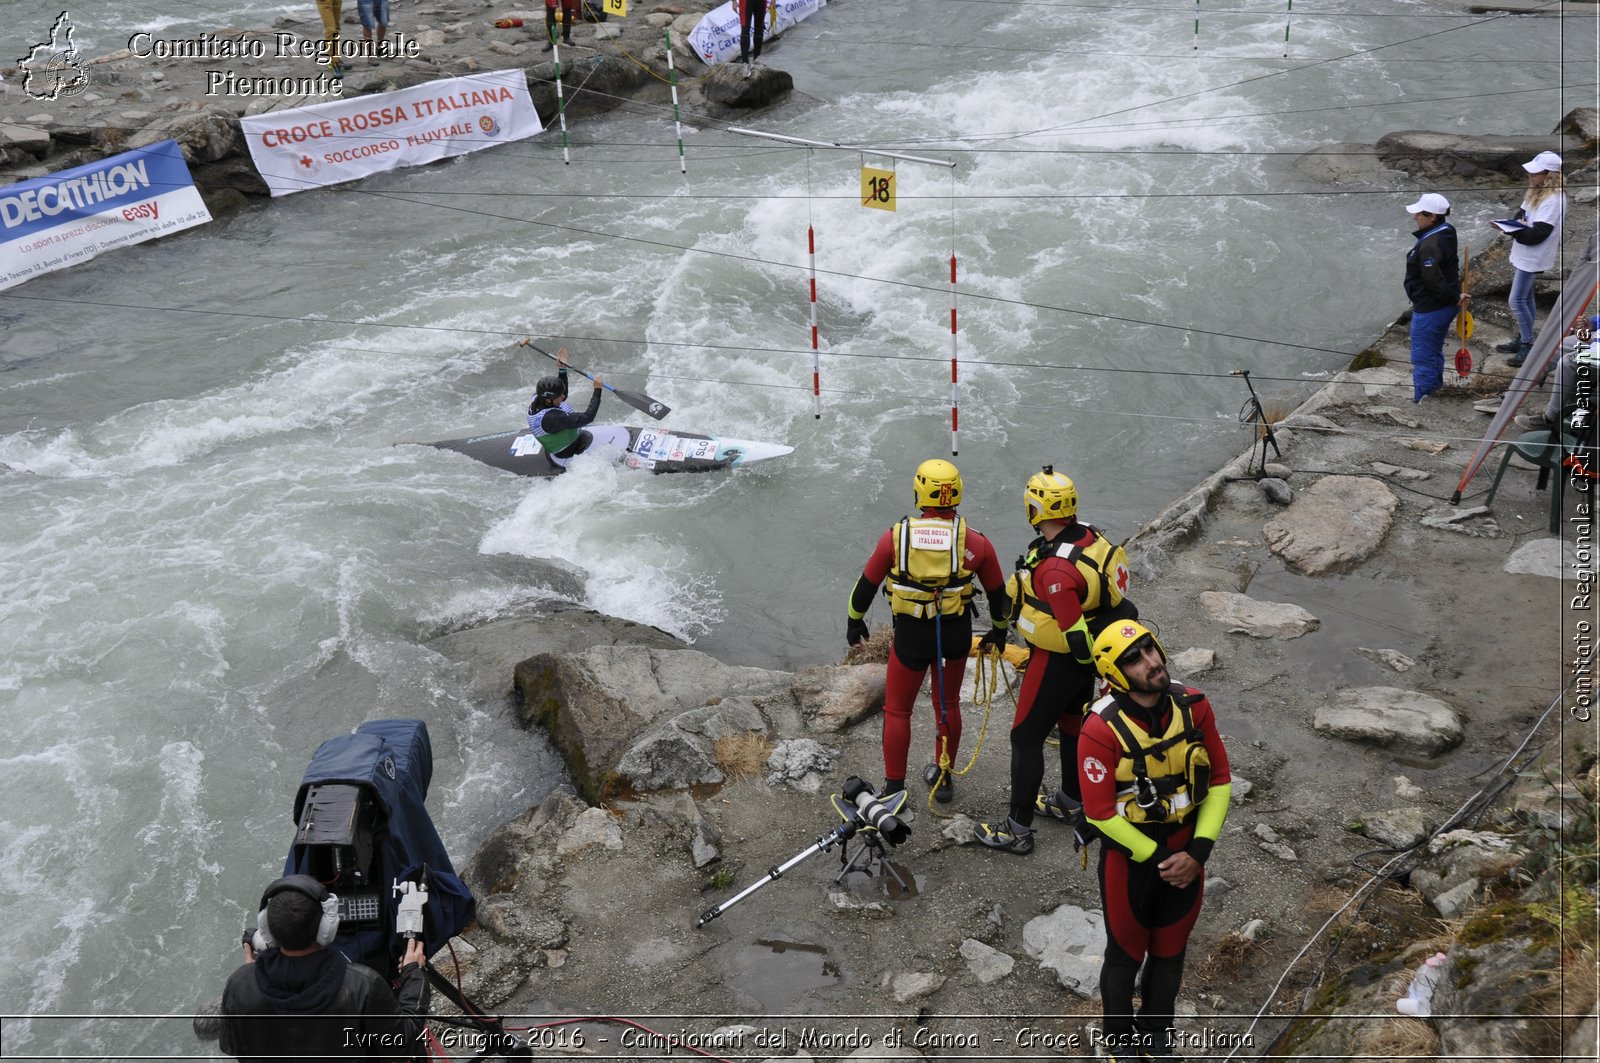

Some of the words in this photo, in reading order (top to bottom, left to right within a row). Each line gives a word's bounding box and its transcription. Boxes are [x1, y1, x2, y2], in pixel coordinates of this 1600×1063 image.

[261, 120, 333, 148] CROCE
[338, 107, 409, 134] ROSSA
[412, 87, 514, 118] ITALIANA
[324, 140, 400, 164] SOCCORSO
[406, 122, 473, 147] FLUVIALE
[0, 159, 150, 229] DECATHLON
[868, 176, 890, 203] 18
[122, 201, 158, 222] easy
[8, 268, 33, 280] Toscana
[83, 242, 98, 255] (TO)
[100, 236, 128, 249] Domenica
[129, 228, 149, 239] sempre
[162, 220, 177, 230] dalle
[196, 210, 206, 218] 20
[19, 245, 32, 254] Lo
[33, 237, 54, 250] sport
[61, 229, 85, 243] prezzi
[85, 216, 119, 232] discount
[696, 441, 709, 457] SLO
